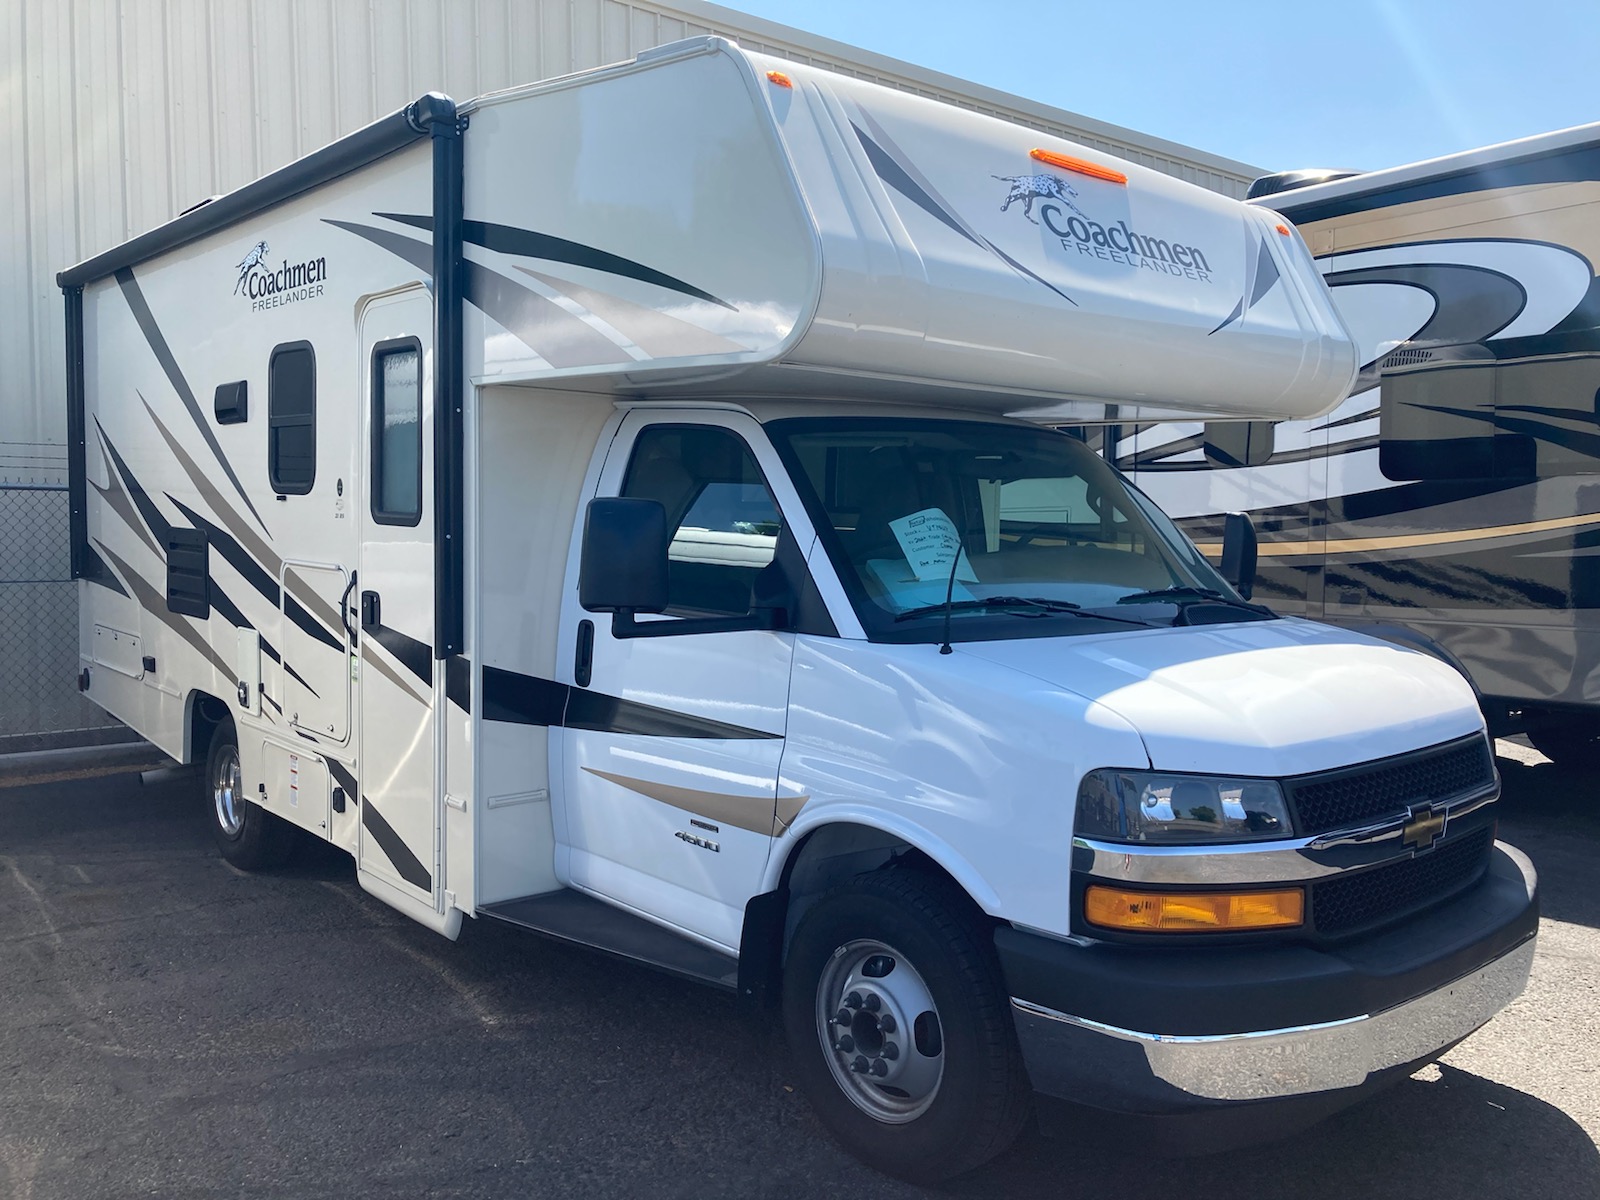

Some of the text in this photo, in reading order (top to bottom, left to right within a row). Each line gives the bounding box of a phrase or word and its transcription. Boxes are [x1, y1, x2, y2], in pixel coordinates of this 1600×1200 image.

[1041, 204, 1212, 272] Coachmen
[249, 257, 327, 300] Coachmen
[1060, 239, 1212, 283] FREELANDER
[252, 285, 324, 312] FREELANDER
